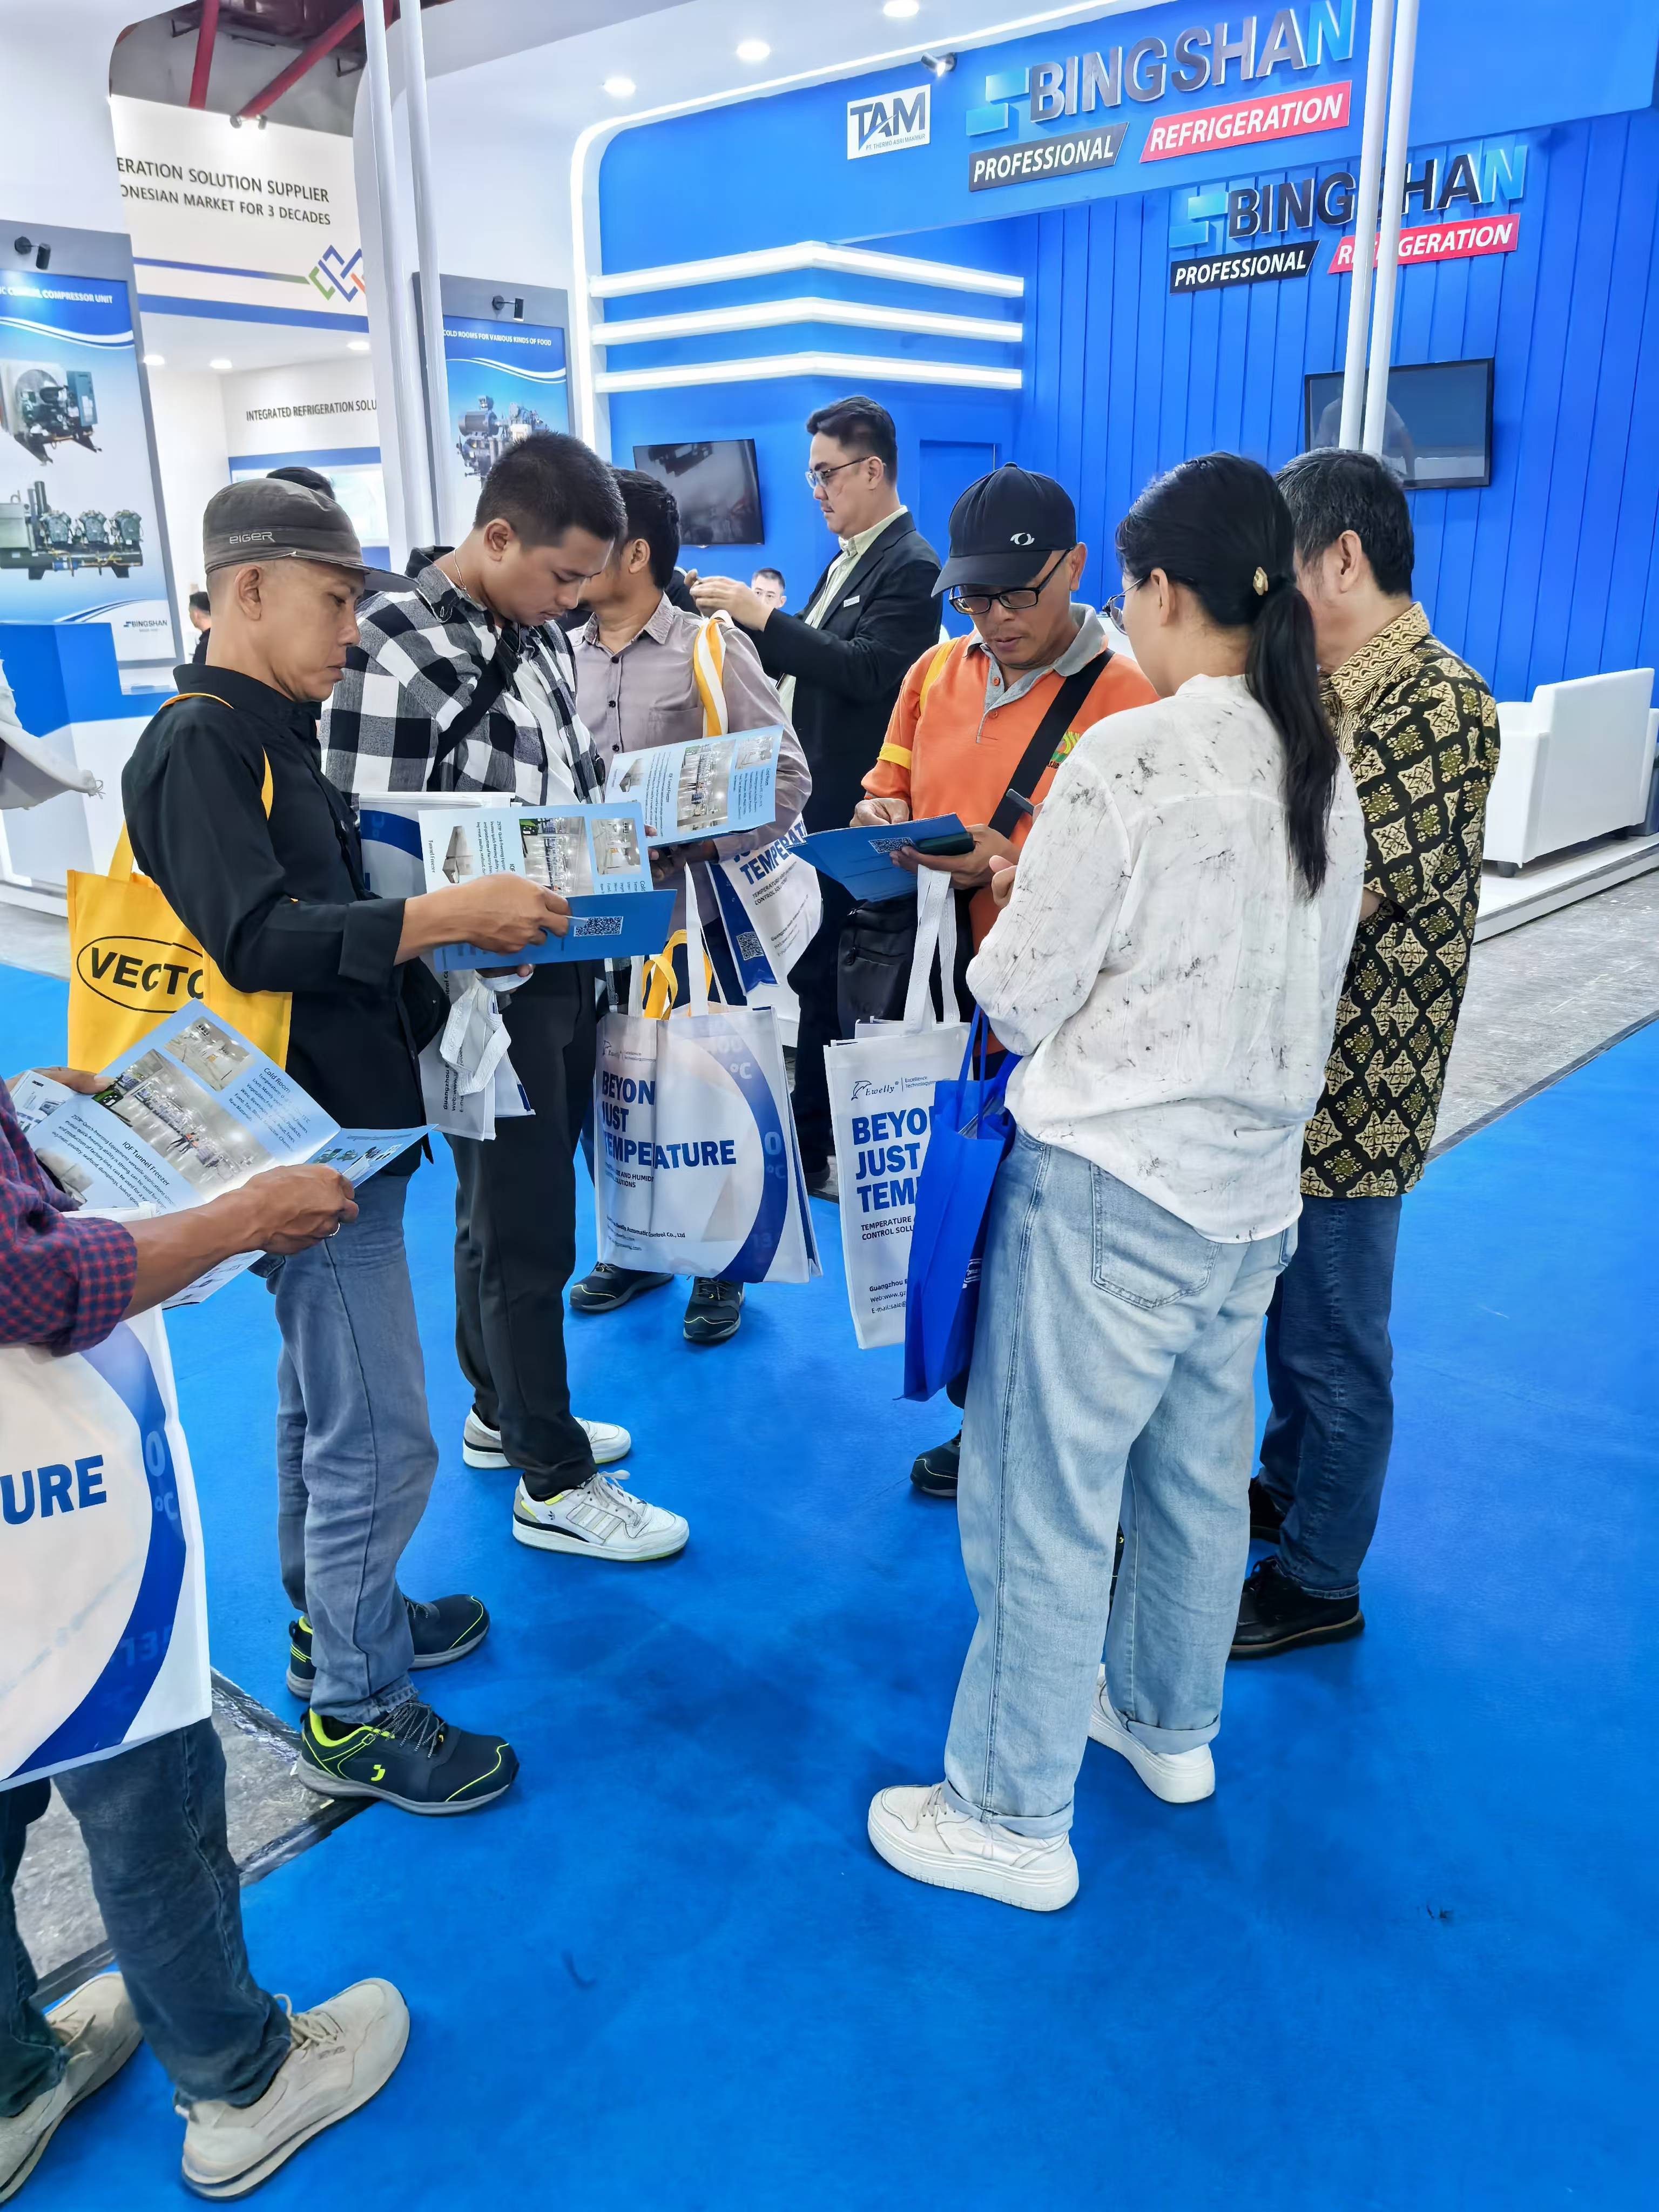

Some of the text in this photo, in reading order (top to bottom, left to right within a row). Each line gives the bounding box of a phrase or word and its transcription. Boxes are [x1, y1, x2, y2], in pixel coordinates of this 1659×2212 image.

[1030, 0, 1356, 123] BINGSHAN
[850, 91, 926, 151] TAM
[1150, 93, 1344, 152] REFRIGERATION
[874, 140, 892, 149] THERMO
[905, 133, 925, 142] MAKMUR
[974, 136, 1114, 183] PROFESSIONAL
[117, 157, 329, 203] ERATION SOLUTION SUPPLIER
[1229, 145, 1528, 238] BINGHAN
[184, 193, 235, 212] MARKET
[240, 201, 264, 217] FOR
[268, 205, 274, 217] 3
[279, 206, 331, 225] DECADES
[1338, 222, 1512, 265] RGERATION
[1175, 249, 1306, 287] PROFESSIONAL
[42, 289, 95, 302] COMPRESSOR
[95, 294, 113, 304] UNIT
[443, 329, 457, 338] COLD
[458, 331, 478, 339] ROOMS
[489, 334, 512, 343] VARIOUS
[246, 407, 292, 421] INTEGRATED
[293, 401, 354, 417] REFRIGERATION
[230, 532, 276, 544] EIGER
[739, 817, 807, 885] TEMPERAT
[263, 1067, 277, 1080] Cold
[852, 1106, 931, 1145] BEYO
[120, 1140, 172, 1187] IQF Tunnel Freezer
[604, 1130, 736, 1169] TEMPEATURE
[856, 1142, 920, 1180] JUST
[857, 1176, 920, 1213] TEM
[861, 1216, 912, 1231] TEMPERATURE
[862, 1228, 894, 1240] CONTROL
[869, 1279, 903, 1291] Guangzhou
[0, 1454, 107, 1525] URE
